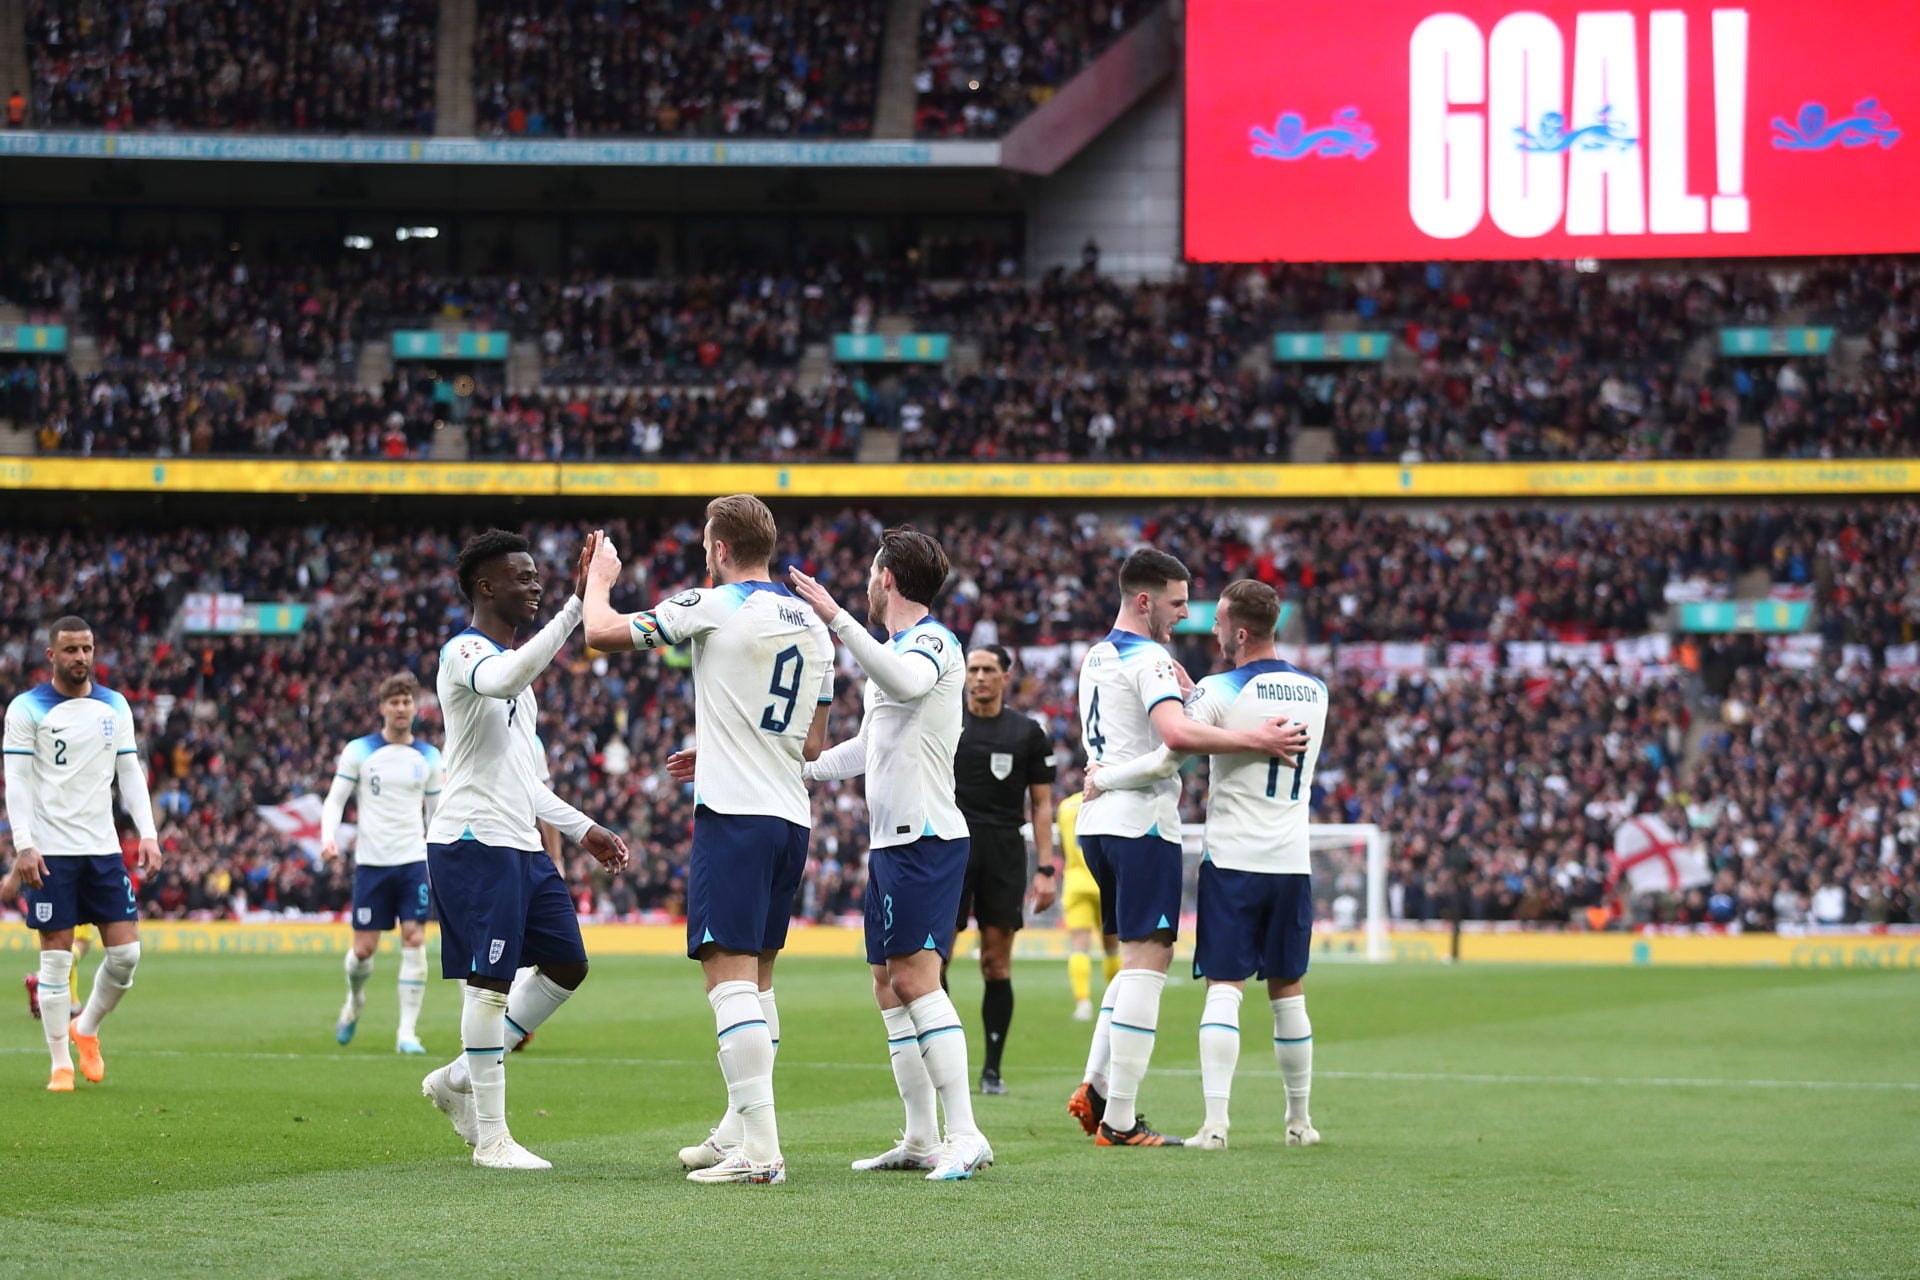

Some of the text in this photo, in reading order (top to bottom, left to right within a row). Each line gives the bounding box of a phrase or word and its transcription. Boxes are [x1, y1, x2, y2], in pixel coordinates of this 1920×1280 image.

[1409, 9, 1750, 239] GOAL!
[119, 139, 216, 158] WEMBLEY
[222, 142, 344, 160] CONNECTED
[425, 143, 521, 162] WEMBLEY
[527, 145, 649, 163] CONNECTED
[730, 145, 826, 163] WEMBLEY
[283, 468, 351, 485] COUNT
[415, 469, 440, 486] TO
[445, 470, 489, 486] KEEP
[497, 470, 536, 487] YOU
[543, 470, 658, 488] CONNECTED
[907, 471, 974, 488] COUNT
[1039, 471, 1064, 488] TO
[1068, 471, 1113, 488] KEEP
[1121, 471, 1159, 488] YOU
[1166, 471, 1279, 488] CONNECTED
[1528, 470, 1598, 488] COUNT
[1664, 469, 1689, 486] TO
[1693, 468, 1738, 485] KEEP
[1746, 468, 1785, 485] YOU
[1792, 466, 1909, 486] CONNECTED
[777, 603, 810, 628] KANE
[759, 643, 805, 734] 9
[1256, 682, 1318, 704] MADDISON
[1086, 685, 1106, 761] 4
[54, 738, 68, 766] 2
[123, 875, 136, 903] 2
[883, 893, 894, 931] 3
[1791, 943, 1901, 969] COUNT
